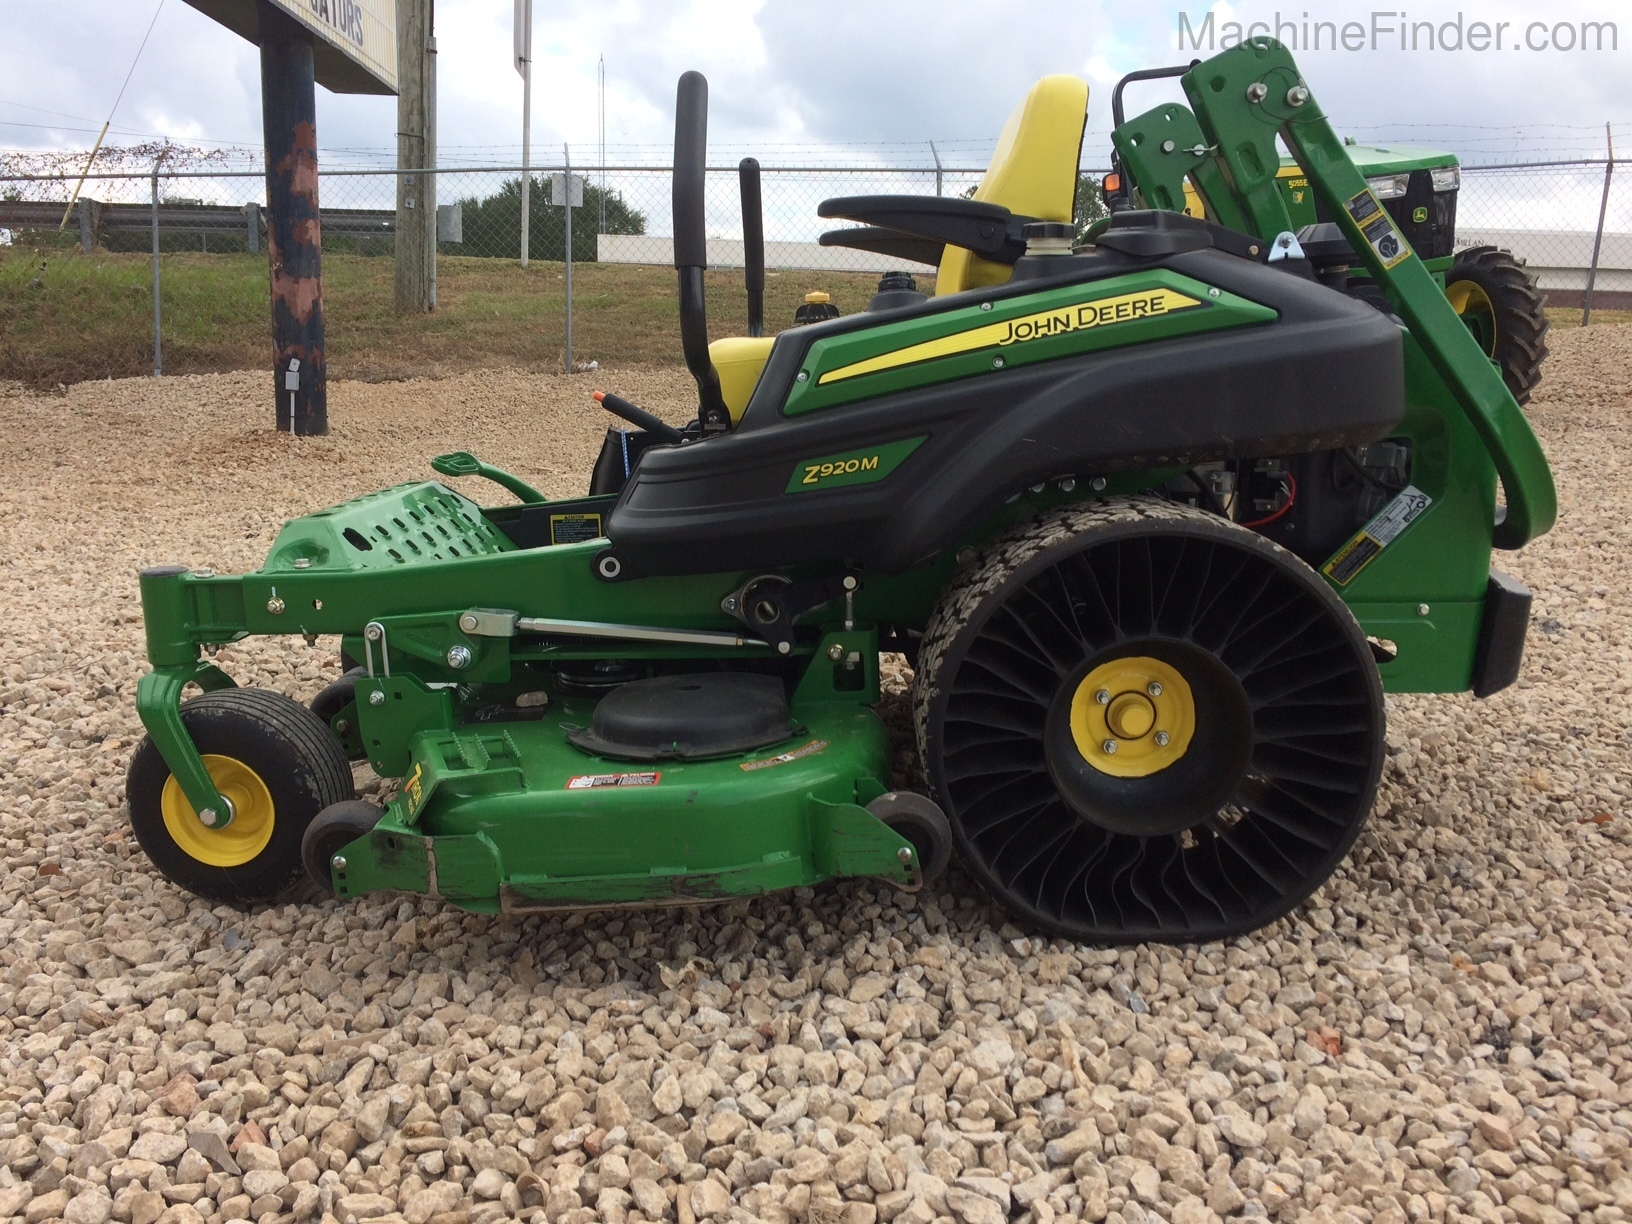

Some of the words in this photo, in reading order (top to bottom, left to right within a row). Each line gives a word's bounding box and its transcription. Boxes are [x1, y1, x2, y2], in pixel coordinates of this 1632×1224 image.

[1288, 179, 1309, 189] 5055E
[999, 313, 1070, 343] JOHN
[1077, 295, 1166, 327] DEERE
[802, 456, 879, 484] Z920M
